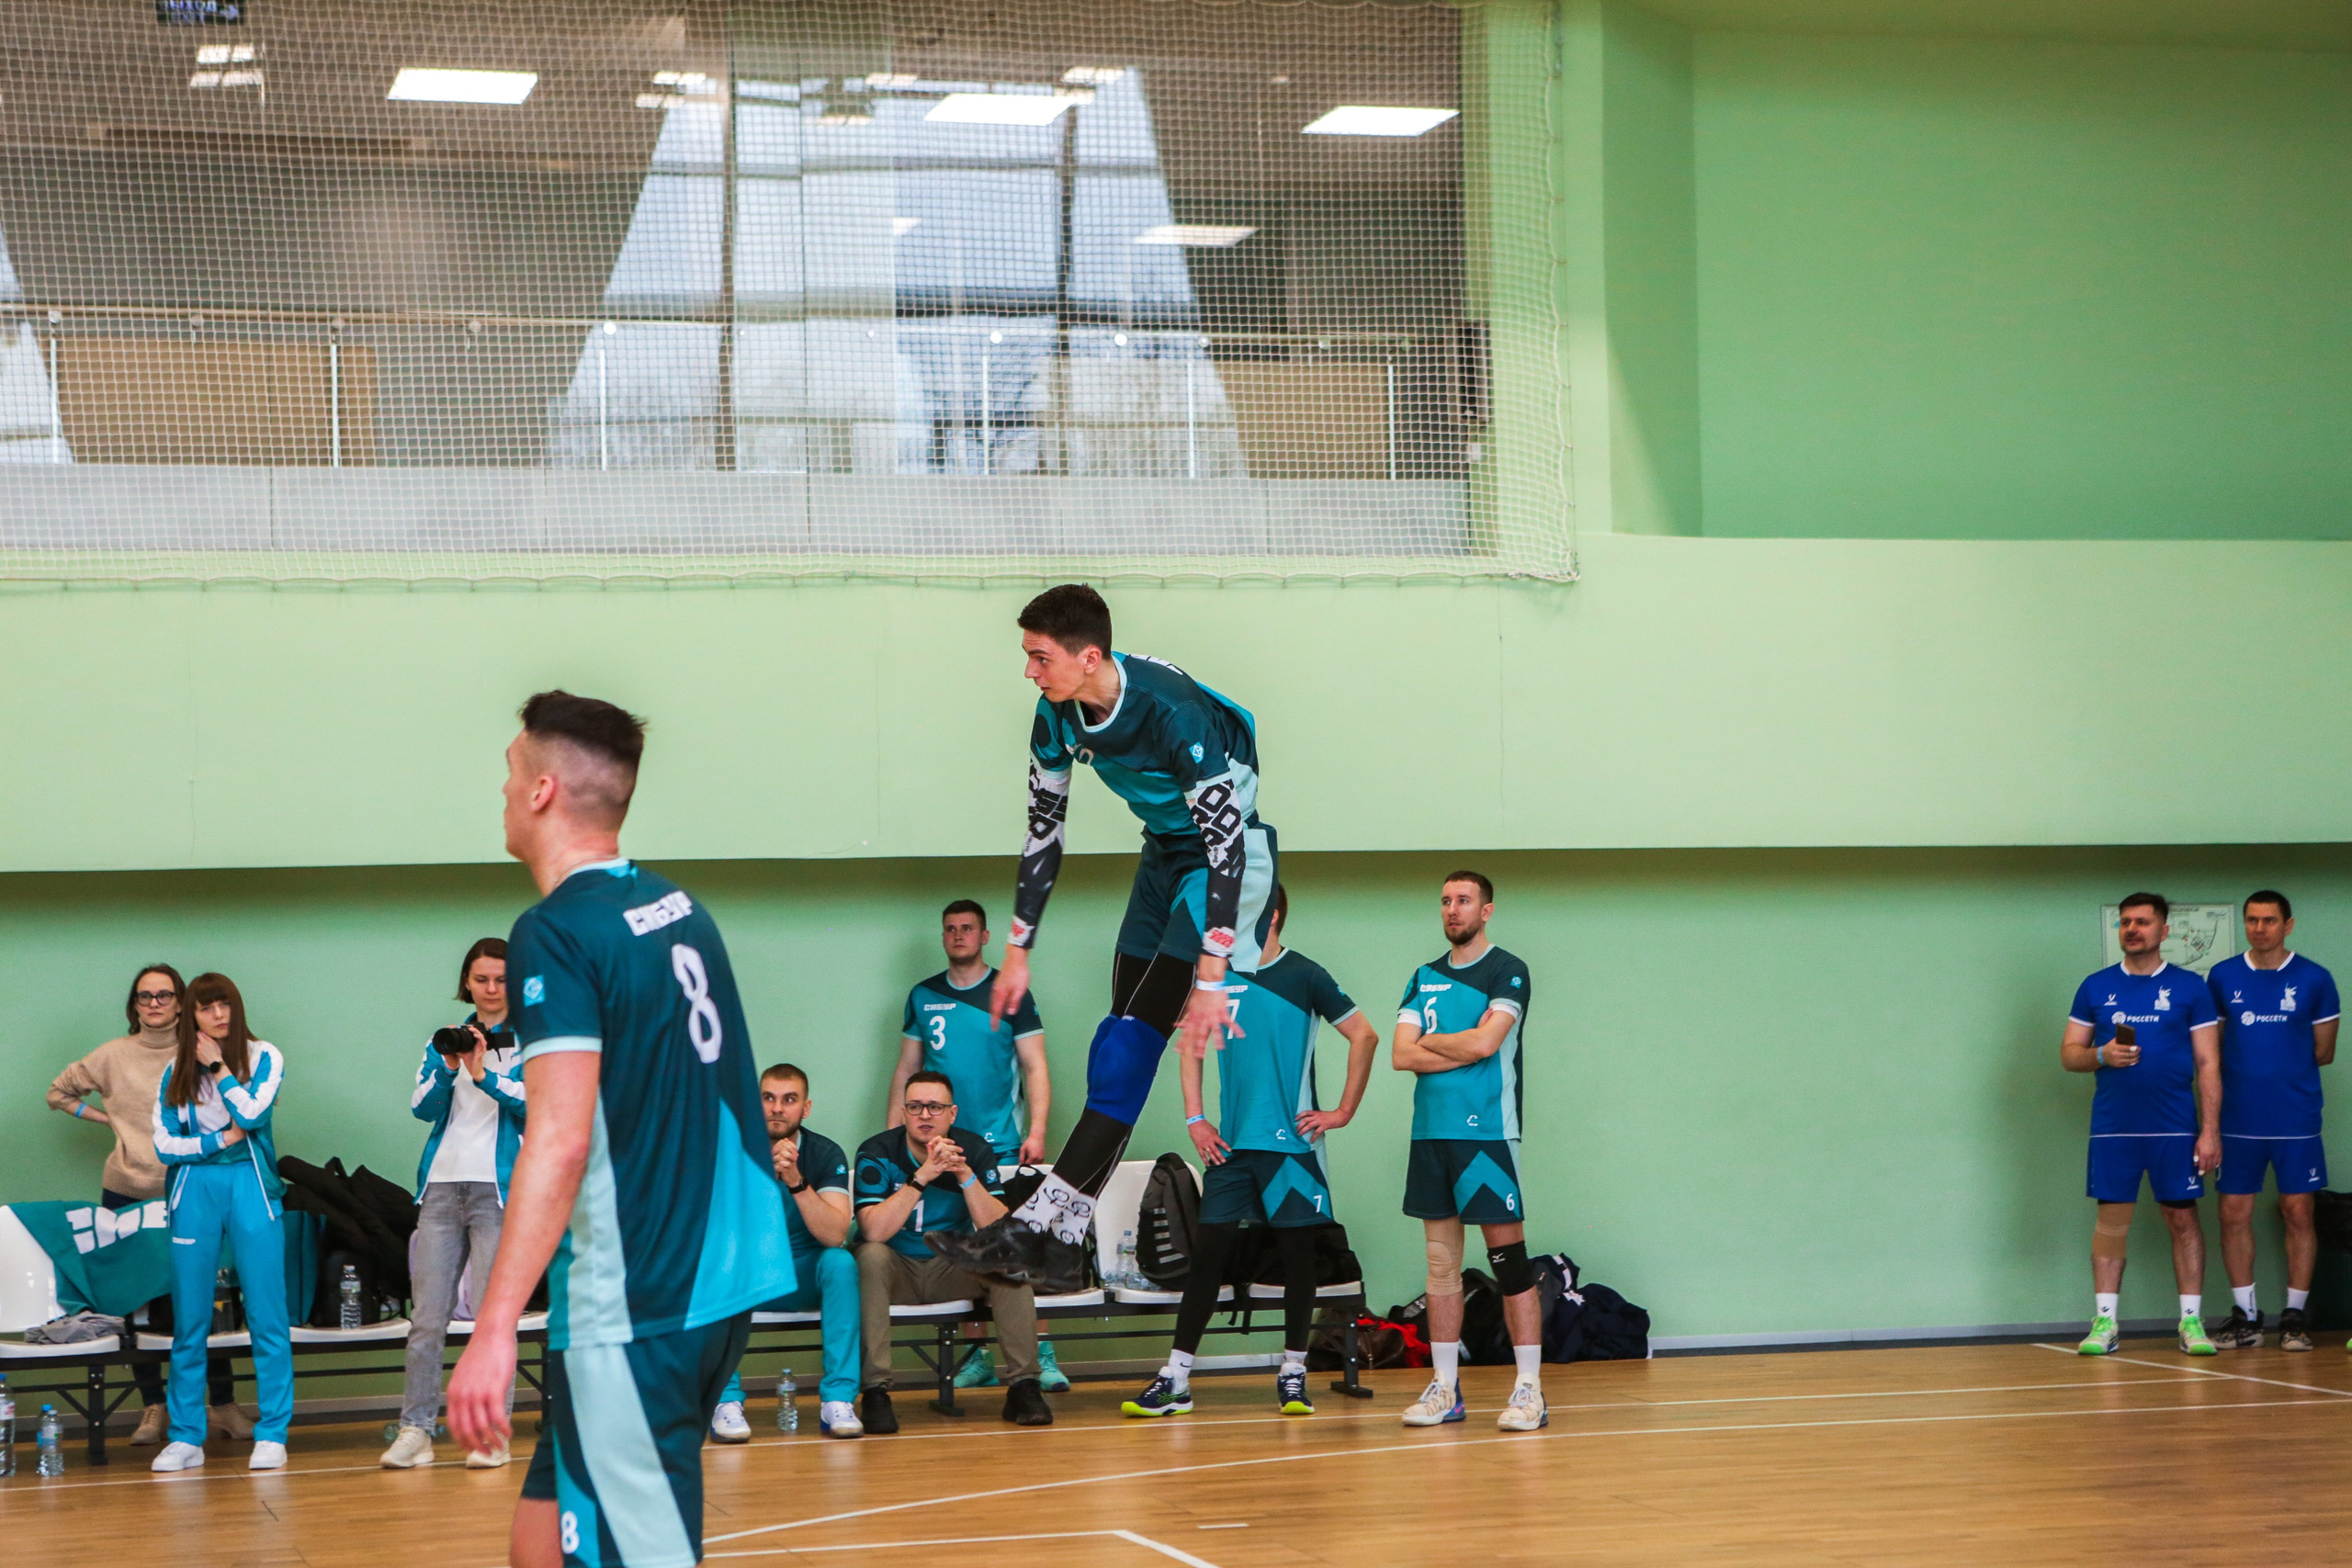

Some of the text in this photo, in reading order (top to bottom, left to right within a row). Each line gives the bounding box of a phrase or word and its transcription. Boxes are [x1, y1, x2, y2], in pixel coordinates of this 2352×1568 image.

[623, 890, 693, 937] СИБУР
[1224, 985, 1249, 993] ИБУР
[1419, 984, 1452, 992] СИБУР
[672, 943, 723, 1064] 8
[923, 1003, 956, 1011] СИБУР
[1226, 998, 1240, 1039] 7
[1423, 997, 1437, 1034] 6
[2127, 1015, 2160, 1023] РОССЕТИ
[2256, 1015, 2288, 1023] РОССЕТИ
[929, 1015, 946, 1051] 3
[1314, 1195, 1322, 1213] 7
[1506, 1193, 1515, 1211] 6
[561, 1510, 580, 1554] 8
